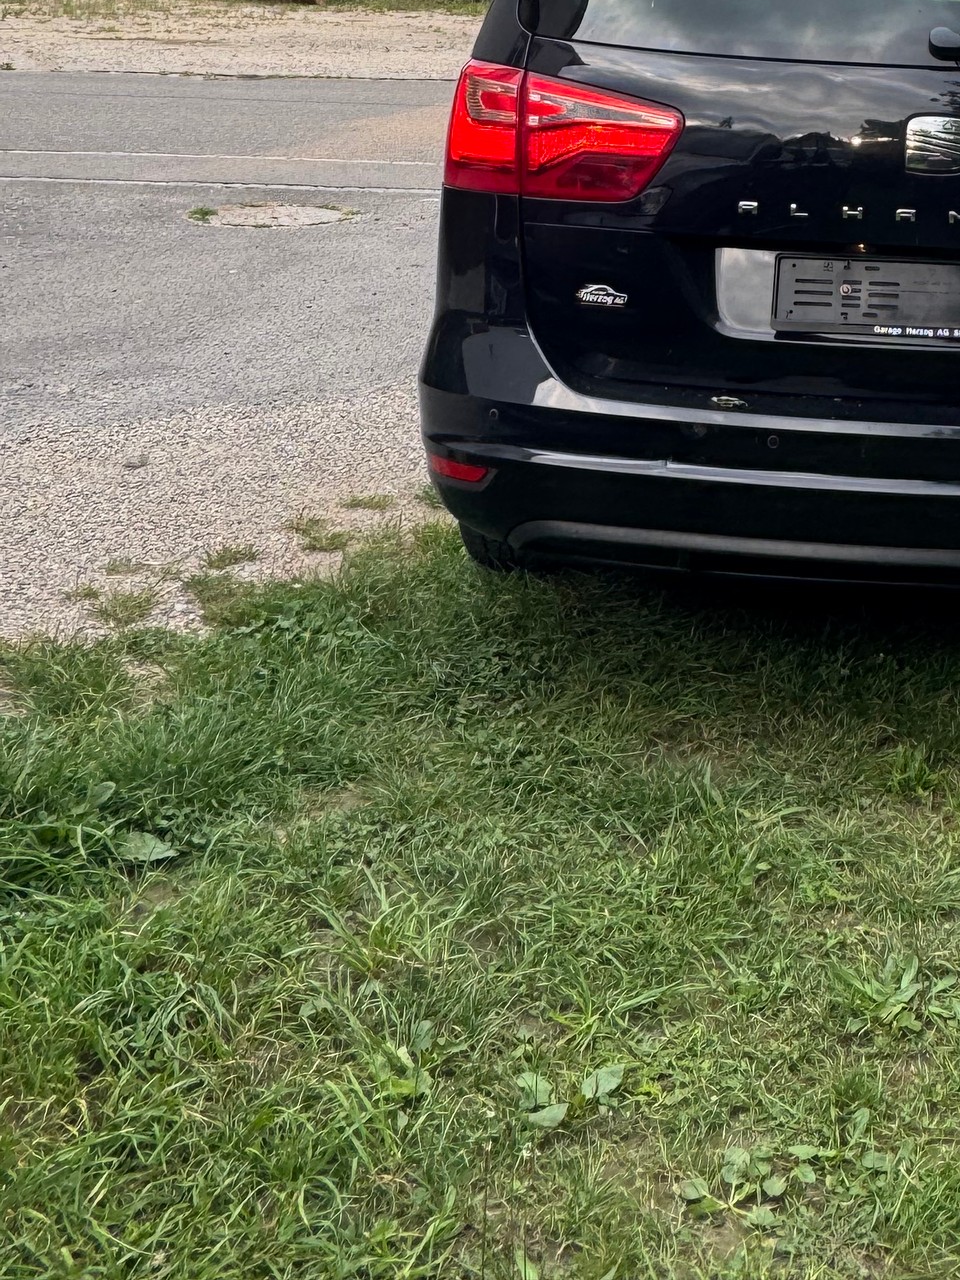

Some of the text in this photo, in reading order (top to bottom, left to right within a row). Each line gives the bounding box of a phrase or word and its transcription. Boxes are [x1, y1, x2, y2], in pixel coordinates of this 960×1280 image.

[873, 325, 902, 335] Garage
[905, 327, 934, 337] Herzog
[936, 328, 950, 337] AG
